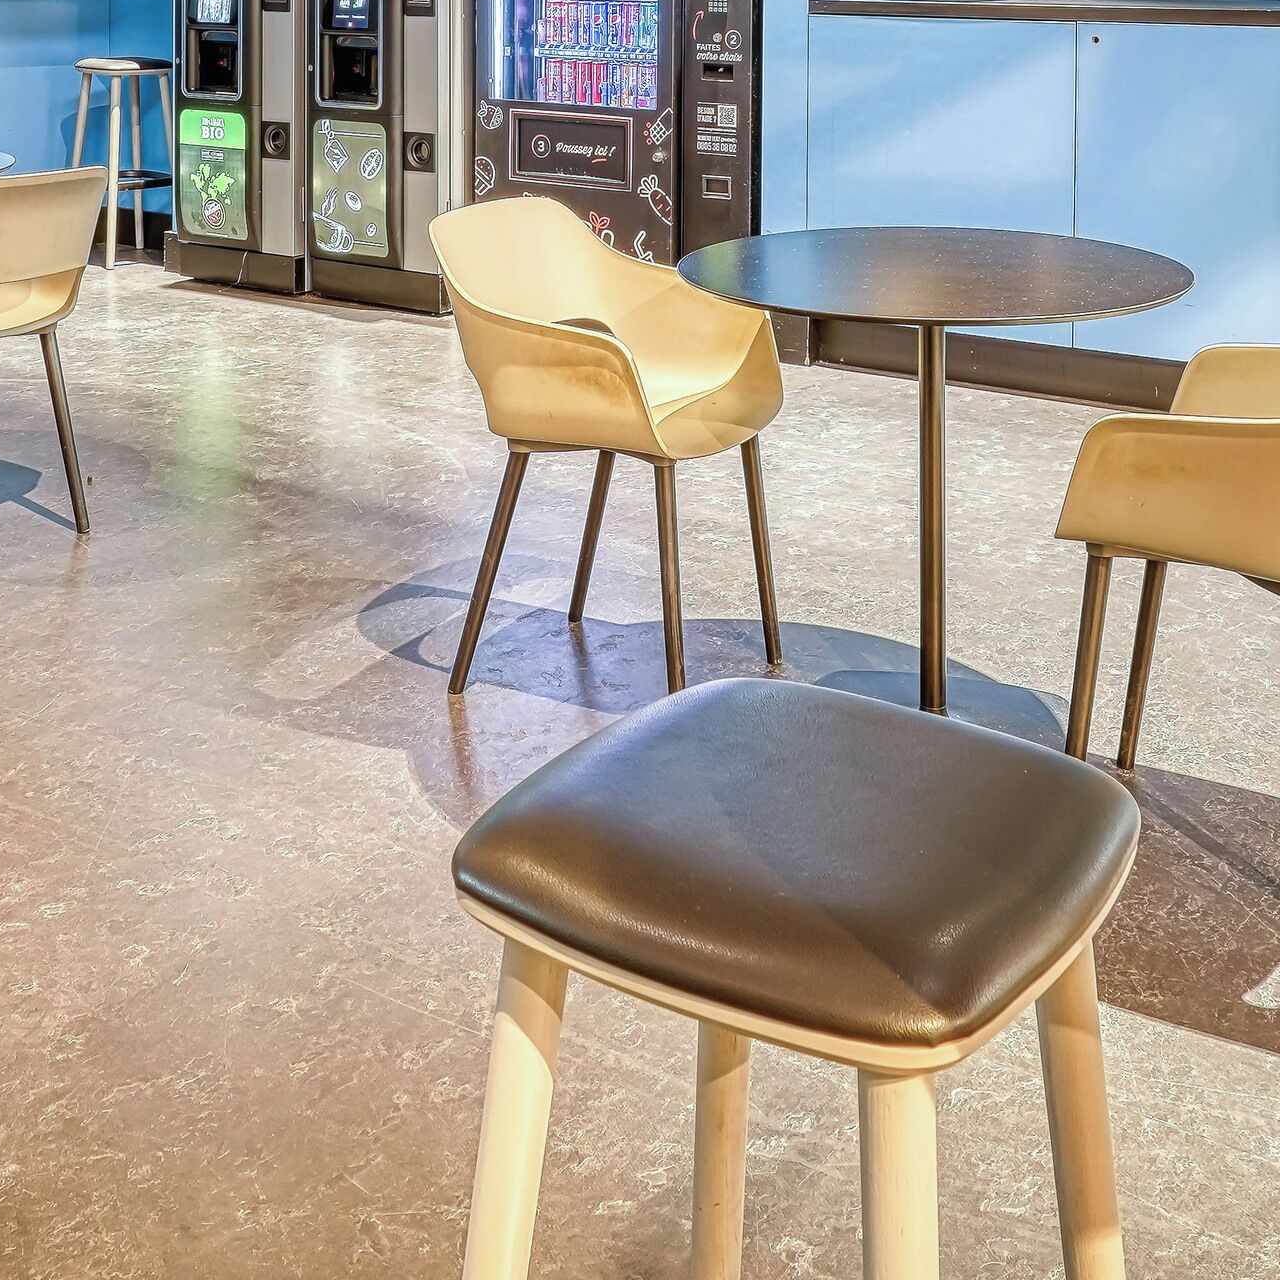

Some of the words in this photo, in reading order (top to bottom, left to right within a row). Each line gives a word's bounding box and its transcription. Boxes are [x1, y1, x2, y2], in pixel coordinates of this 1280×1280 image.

[696, 43, 721, 51] FAITES
[696, 51, 718, 60] votre
[719, 51, 743, 62] choix
[201, 126, 225, 141] BIO
[537, 140, 546, 152] 3
[555, 142, 594, 157] Poussez
[594, 145, 608, 157] ici
[608, 146, 616, 157] !
